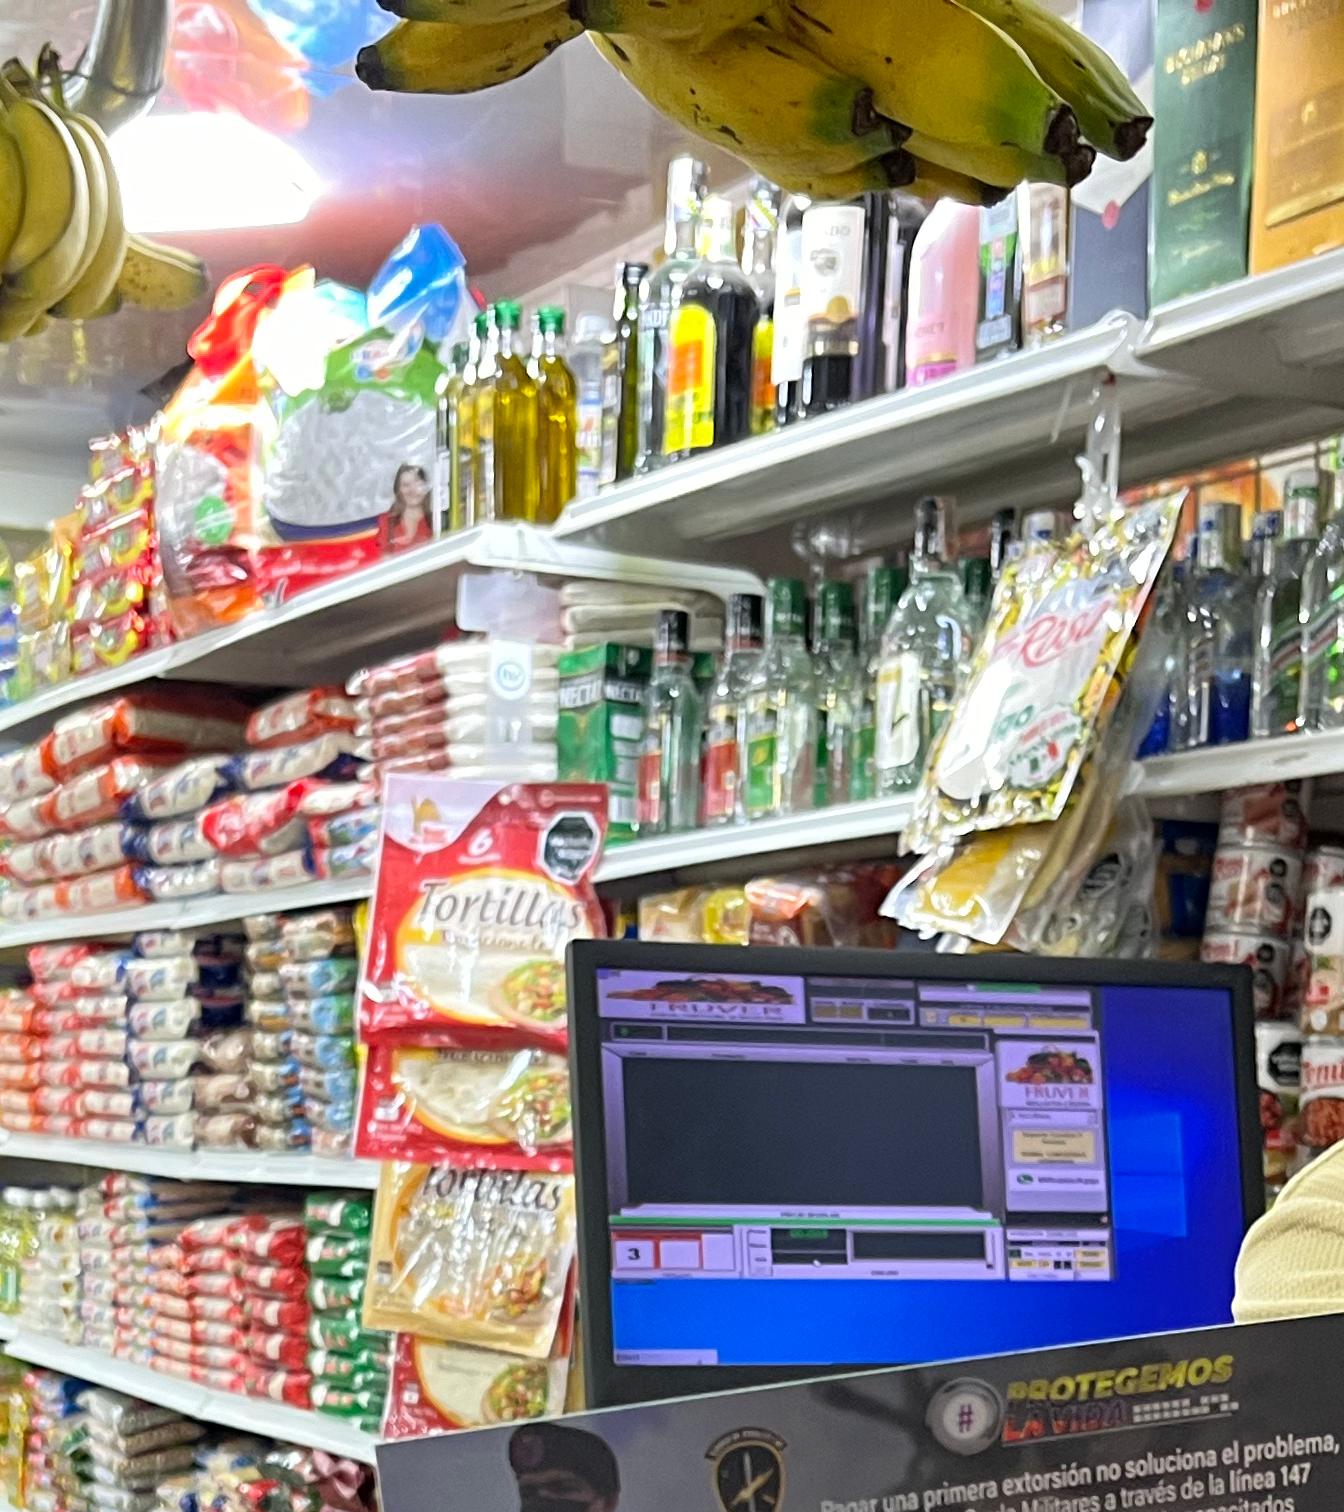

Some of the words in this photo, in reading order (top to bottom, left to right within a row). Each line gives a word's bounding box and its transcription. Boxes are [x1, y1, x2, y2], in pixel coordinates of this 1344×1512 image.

[468, 827, 494, 857] 6
[419, 880, 585, 931] Tortillas
[627, 1247, 641, 1261] 3
[1008, 1354, 1235, 1401] PROTEGEMOS
[1002, 1461, 1092, 1497] extorsión
[1096, 1463, 1122, 1483] no
[1124, 1448, 1218, 1479] soluciona
[1221, 1440, 1240, 1465] el
[1243, 1433, 1341, 1467] problema,
[1104, 1492, 1117, 1511] a
[1120, 1479, 1178, 1509] través
[1180, 1476, 1205, 1500] de
[1208, 1473, 1226, 1496] la
[1229, 1468, 1276, 1493] línea
[1280, 1462, 1312, 1487] 147
